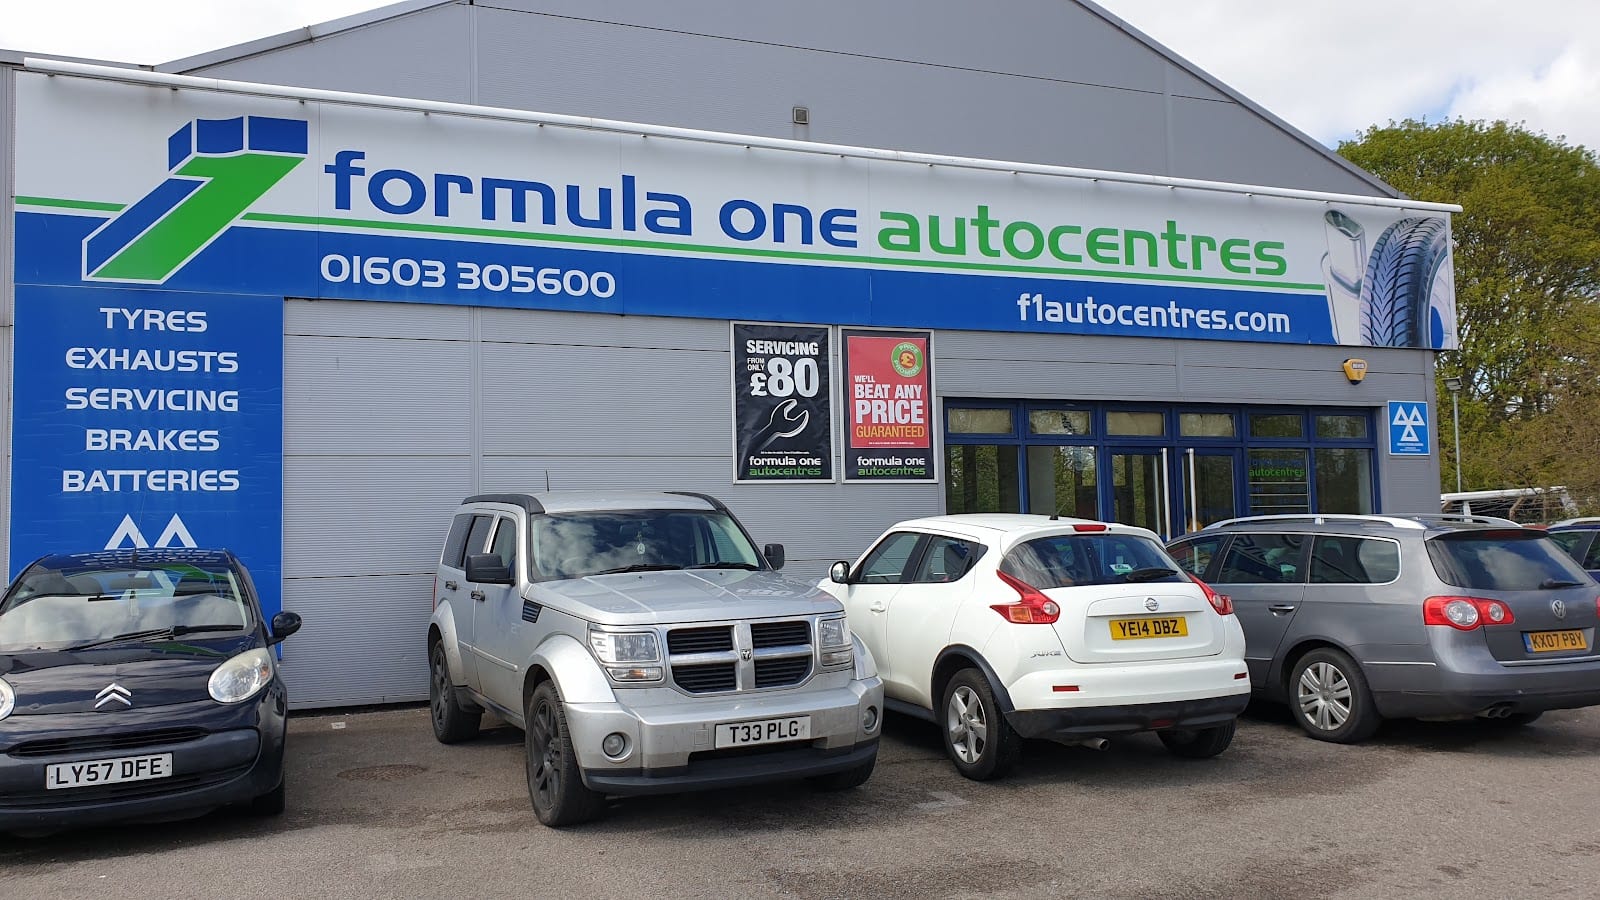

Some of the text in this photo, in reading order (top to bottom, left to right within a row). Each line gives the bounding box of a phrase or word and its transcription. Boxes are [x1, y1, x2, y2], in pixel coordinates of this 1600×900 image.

[324, 150, 1288, 276] formula one autocentres
[320, 253, 616, 298] 01603 305600
[99, 307, 208, 333] TYRES
[1016, 293, 1291, 334] f1autocentres.com
[746, 339, 819, 355] SERVICING
[65, 347, 239, 373] EXHAUSTS
[750, 357, 819, 398] £80
[854, 375, 876, 383] WE'LL
[65, 387, 239, 412] SERVICING
[854, 384, 922, 399] BEAT ANY
[855, 400, 924, 424] PRICE
[86, 428, 220, 451] BRAKES
[856, 425, 925, 438] GUARANTEED
[749, 455, 822, 466] formula one
[749, 466, 822, 476] autocentres
[857, 456, 926, 466] formula one
[857, 466, 926, 476] autocentres
[62, 469, 240, 492] BATTERIES
[1118, 619, 1180, 637] YE14 DBZ
[1531, 632, 1583, 649] KX07 PBY
[729, 720, 798, 744] T33 PLG
[55, 756, 163, 785] LY57 DFE
